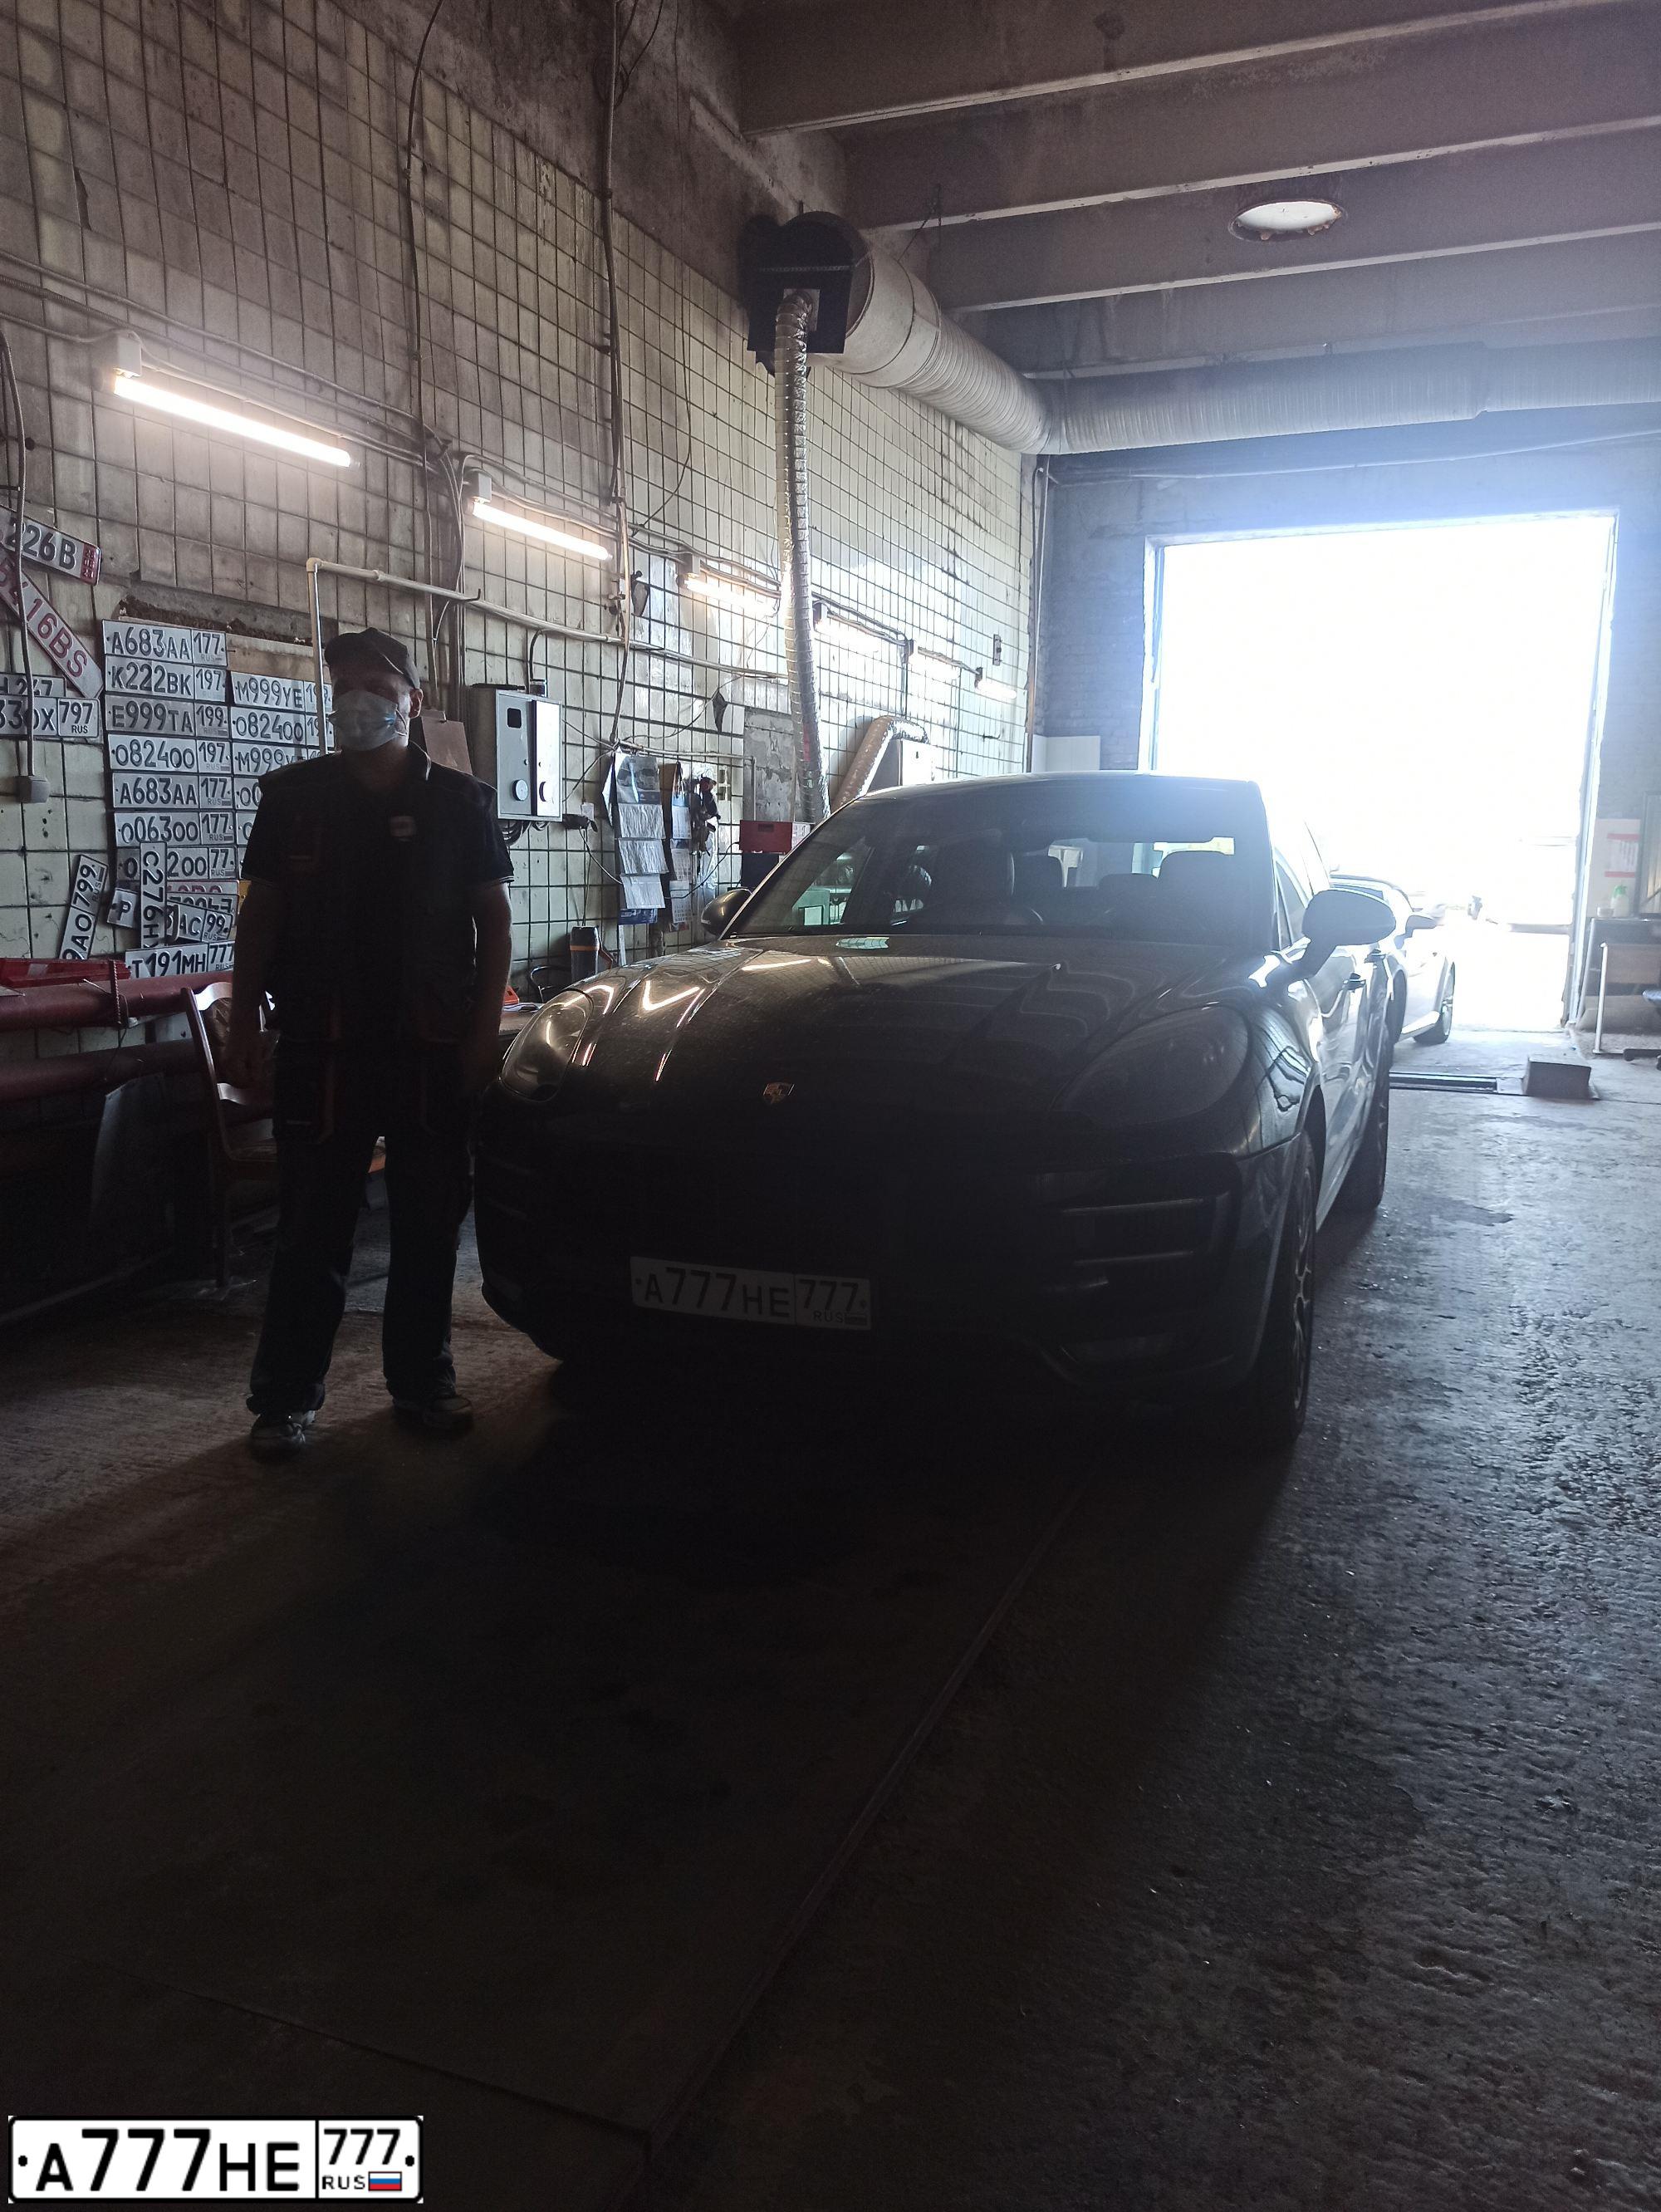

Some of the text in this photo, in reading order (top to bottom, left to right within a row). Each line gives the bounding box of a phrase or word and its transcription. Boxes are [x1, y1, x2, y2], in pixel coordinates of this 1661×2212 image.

[111, 627, 221, 661] A683AA 177
[111, 661, 222, 696] K222BK 197
[59, 701, 94, 724] 797
[113, 700, 224, 733] E999TA 199
[71, 725, 89, 734] RUS
[198, 739, 226, 762] 197
[120, 777, 228, 806] A683AA 177
[201, 814, 229, 836] 177
[211, 849, 228, 869] 77
[73, 864, 96, 907] 799
[207, 914, 226, 934] 99
[644, 1267, 859, 1317] A777HE 777
[813, 1310, 844, 1323] RUS
